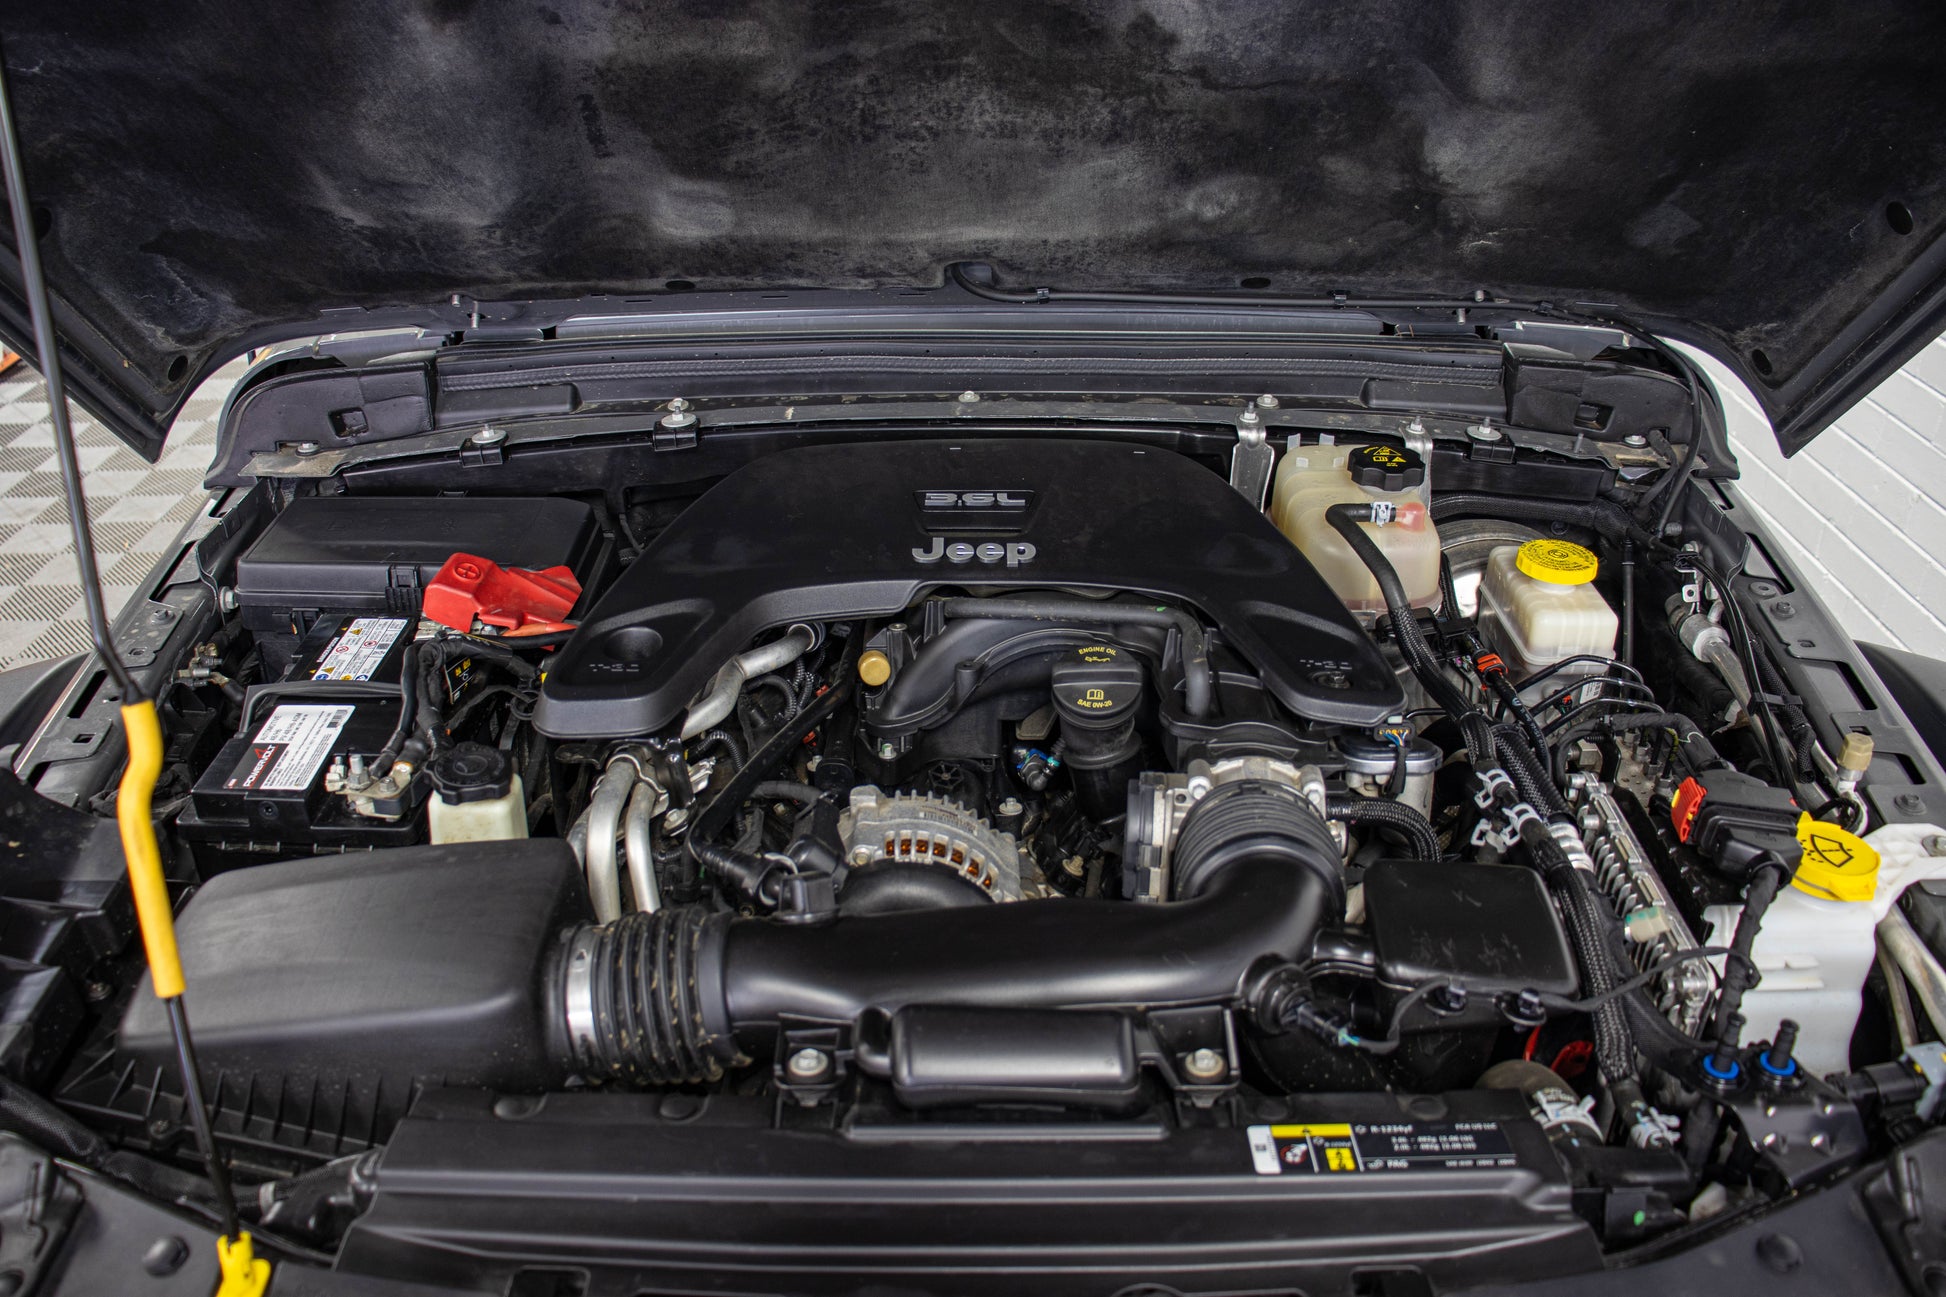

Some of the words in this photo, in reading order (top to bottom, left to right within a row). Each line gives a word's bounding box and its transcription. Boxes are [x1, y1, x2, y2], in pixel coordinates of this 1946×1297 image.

[924, 492, 1026, 507] 3.6L
[911, 537, 1037, 568] Jeep
[1078, 646, 1105, 655] ENGINE
[1106, 647, 1117, 656] OIL
[1077, 698, 1091, 708] SAE
[1092, 700, 1112, 708] 0W-20
[243, 744, 276, 787] POWERVOLT
